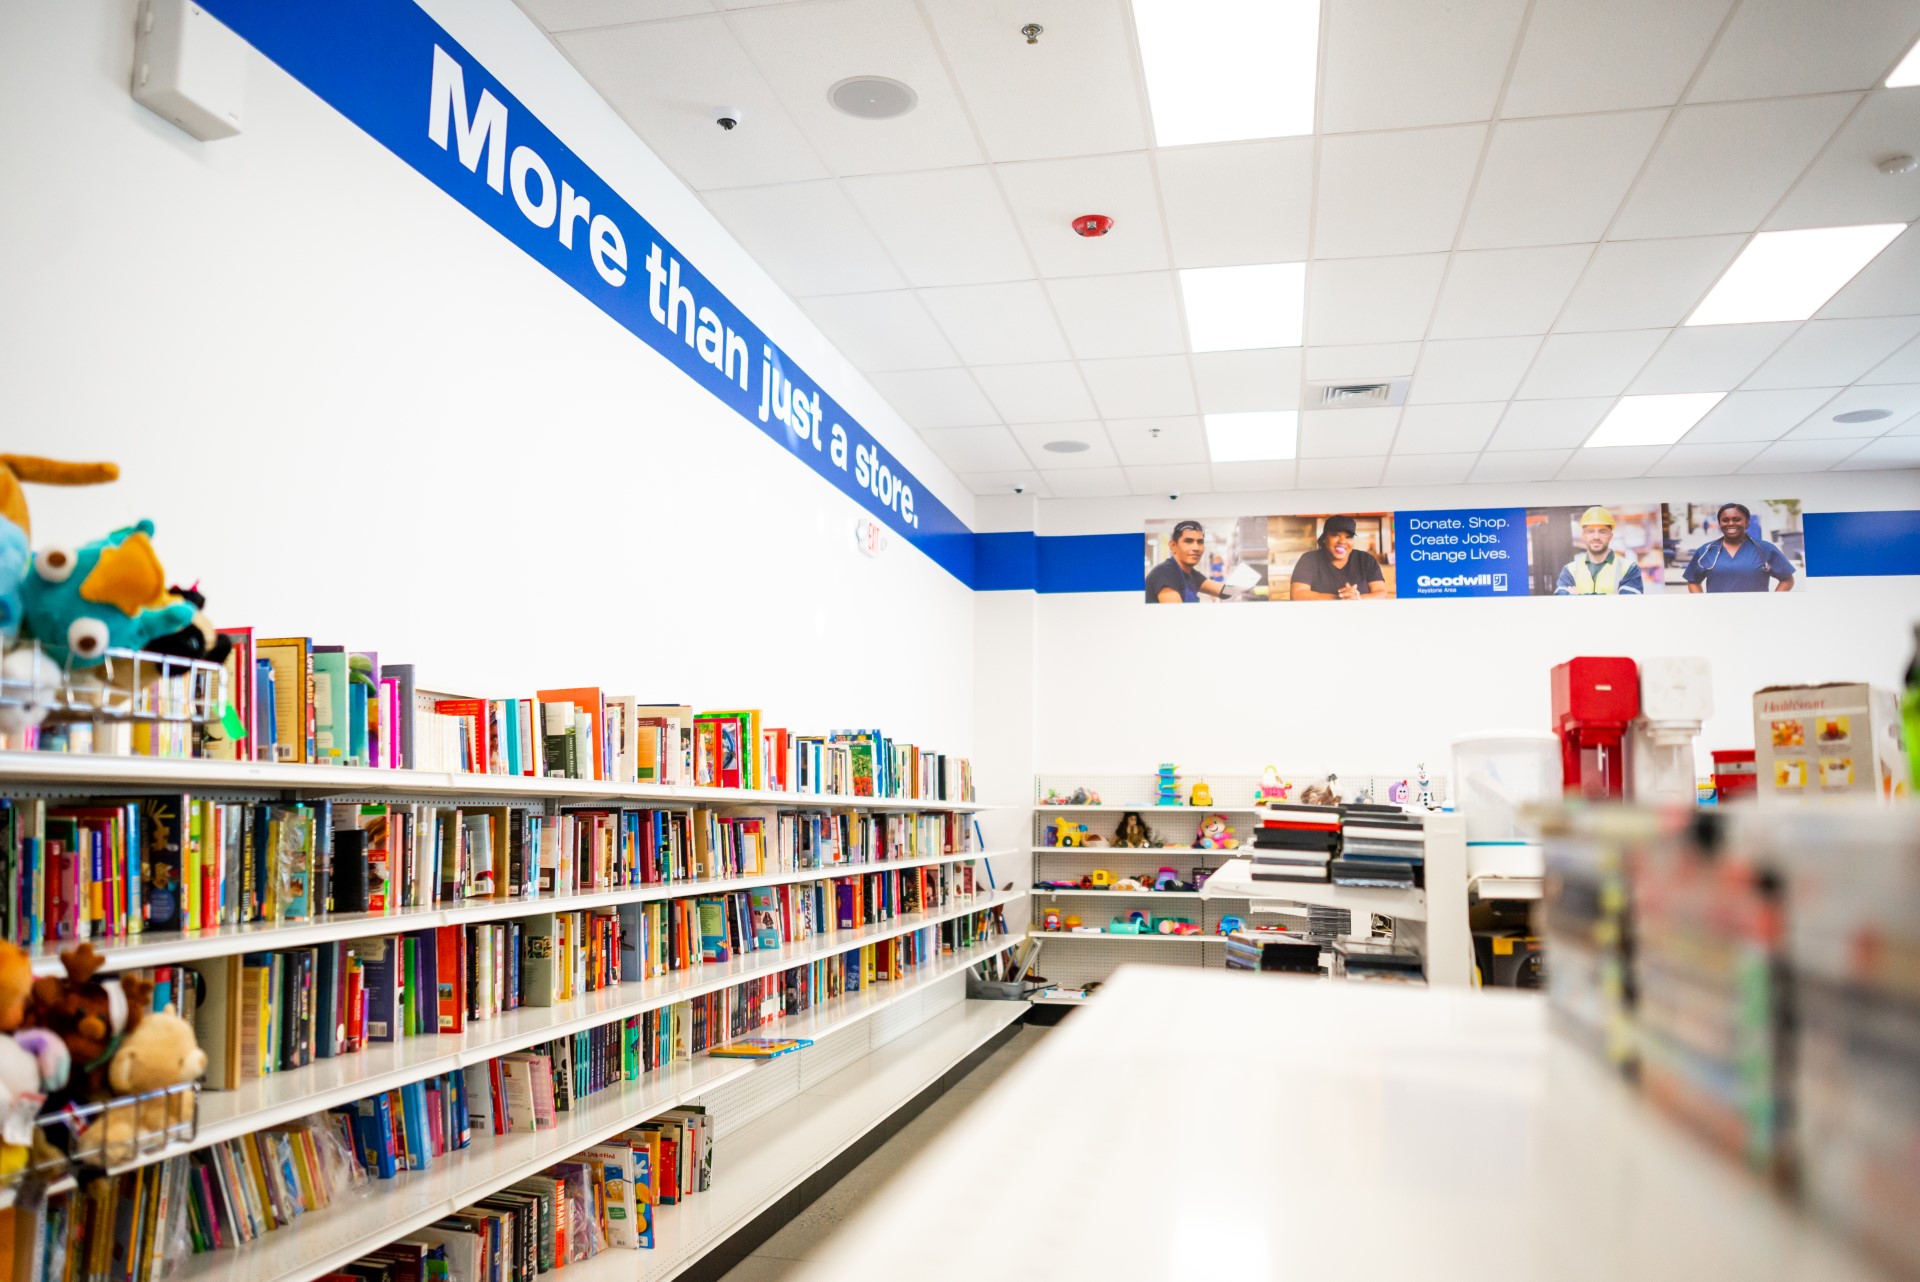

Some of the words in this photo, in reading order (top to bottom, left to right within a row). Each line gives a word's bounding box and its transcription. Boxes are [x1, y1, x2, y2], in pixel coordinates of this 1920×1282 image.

[428, 43, 628, 288] More
[646, 241, 749, 392] than
[759, 343, 823, 452] just
[830, 423, 848, 472] a
[855, 444, 919, 530] store.
[1410, 518, 1465, 530] Donate.
[1469, 517, 1510, 530] Shop.
[1410, 534, 1458, 545] Create
[1462, 533, 1500, 545] Jobs.
[1410, 549, 1467, 563] Change
[1471, 548, 1510, 560] Lives.
[1417, 573, 1491, 587] Goodwill
[306, 653, 314, 674] LOVE
[306, 674, 314, 704] CARDS
